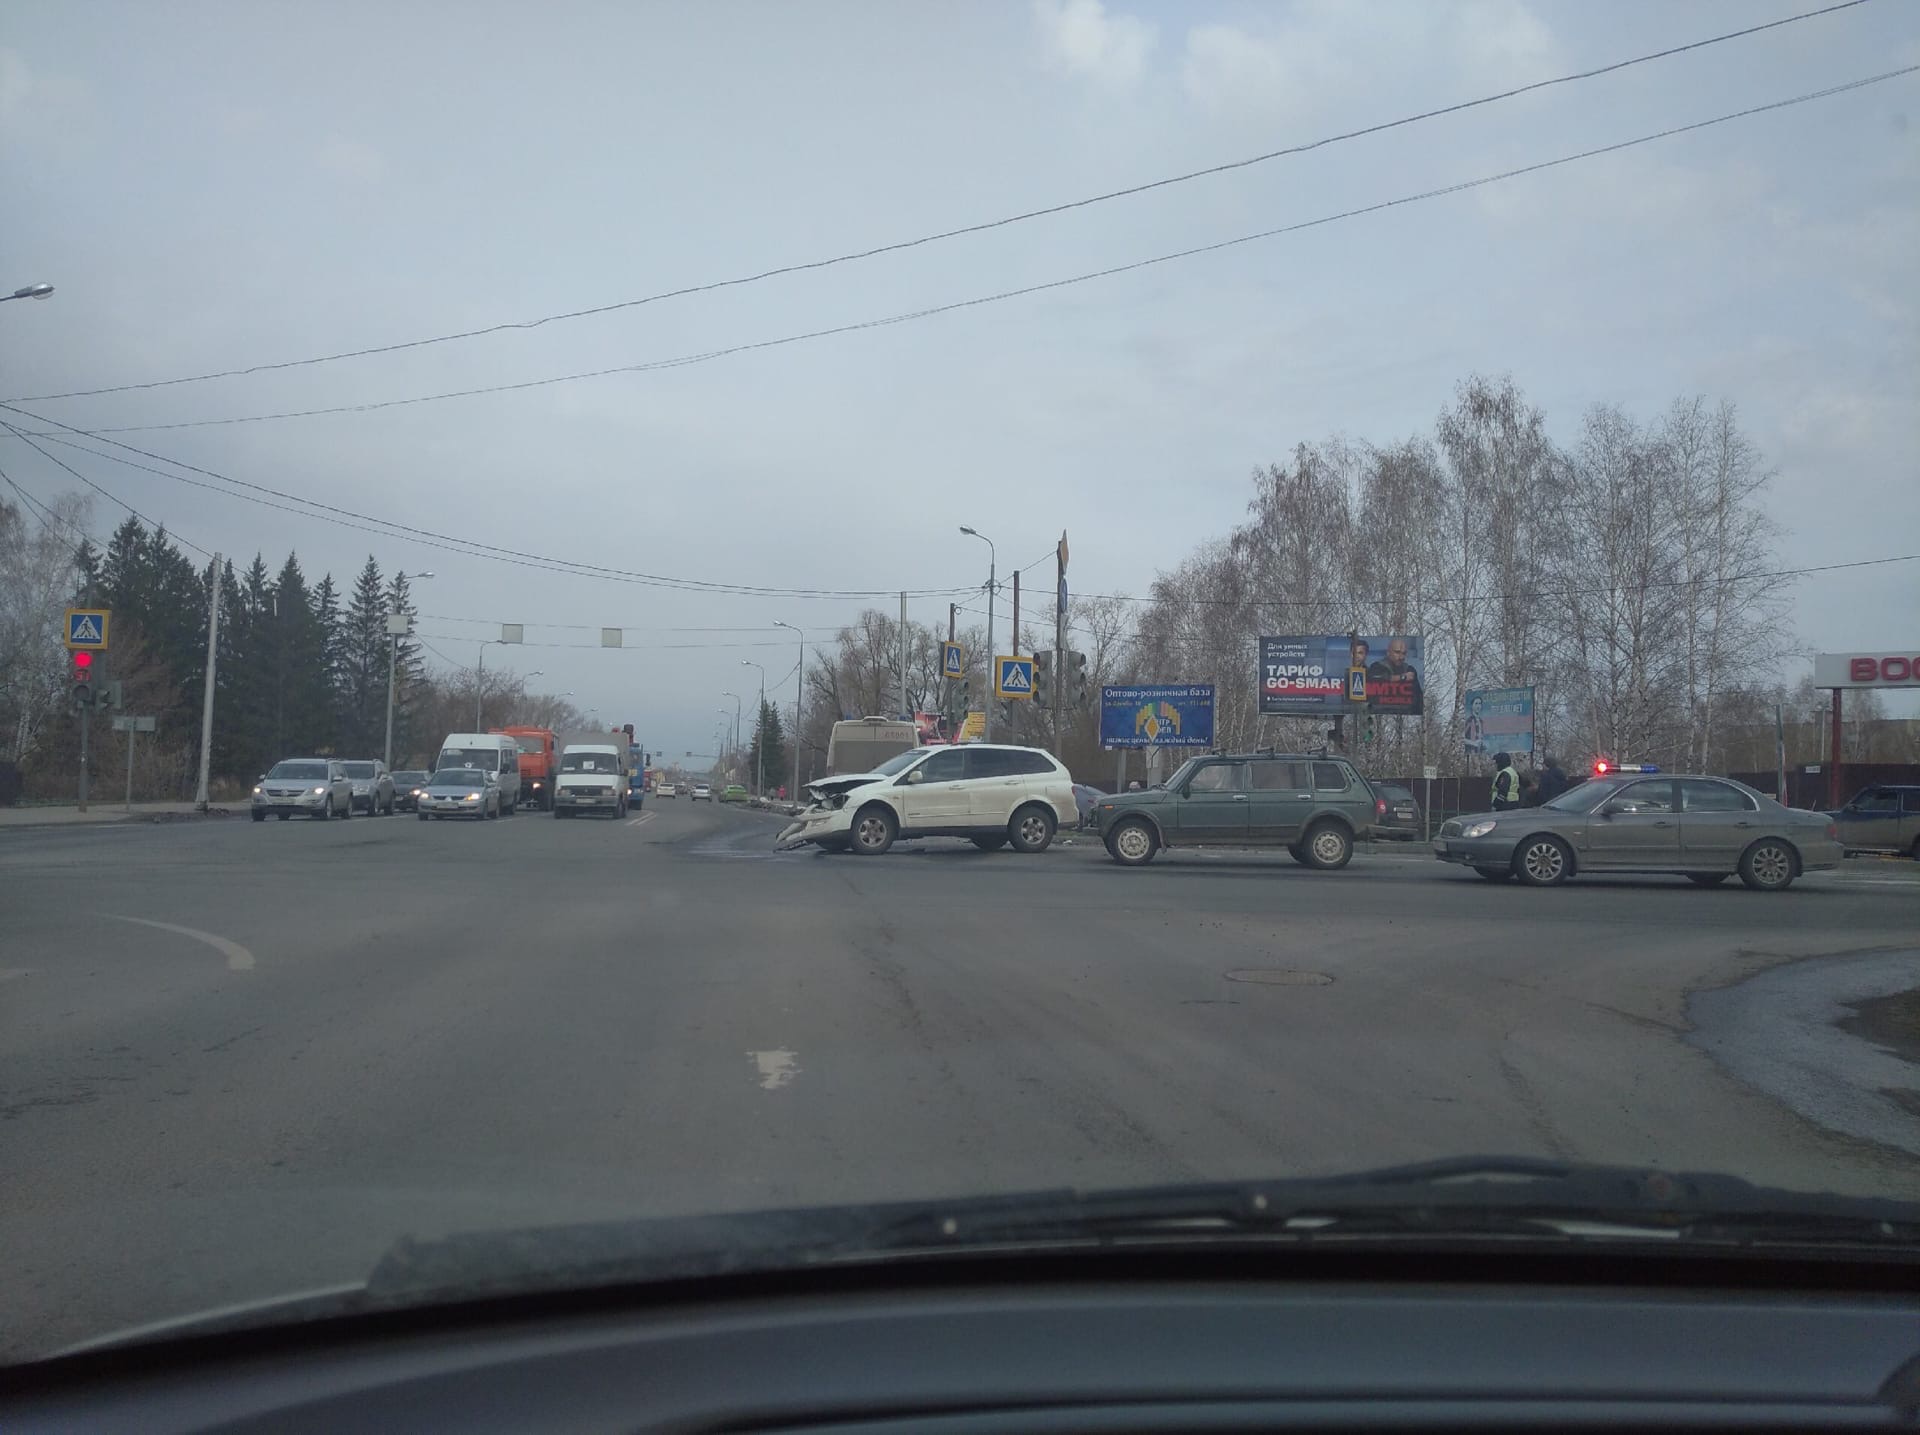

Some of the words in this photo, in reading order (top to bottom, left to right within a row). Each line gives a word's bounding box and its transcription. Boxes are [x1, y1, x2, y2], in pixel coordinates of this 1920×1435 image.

[1266, 664, 1323, 677] ТАРИФ
[1105, 688, 1188, 699] Оптово-розничная
[1189, 687, 1211, 697] база
[1376, 682, 1413, 695] МТС
